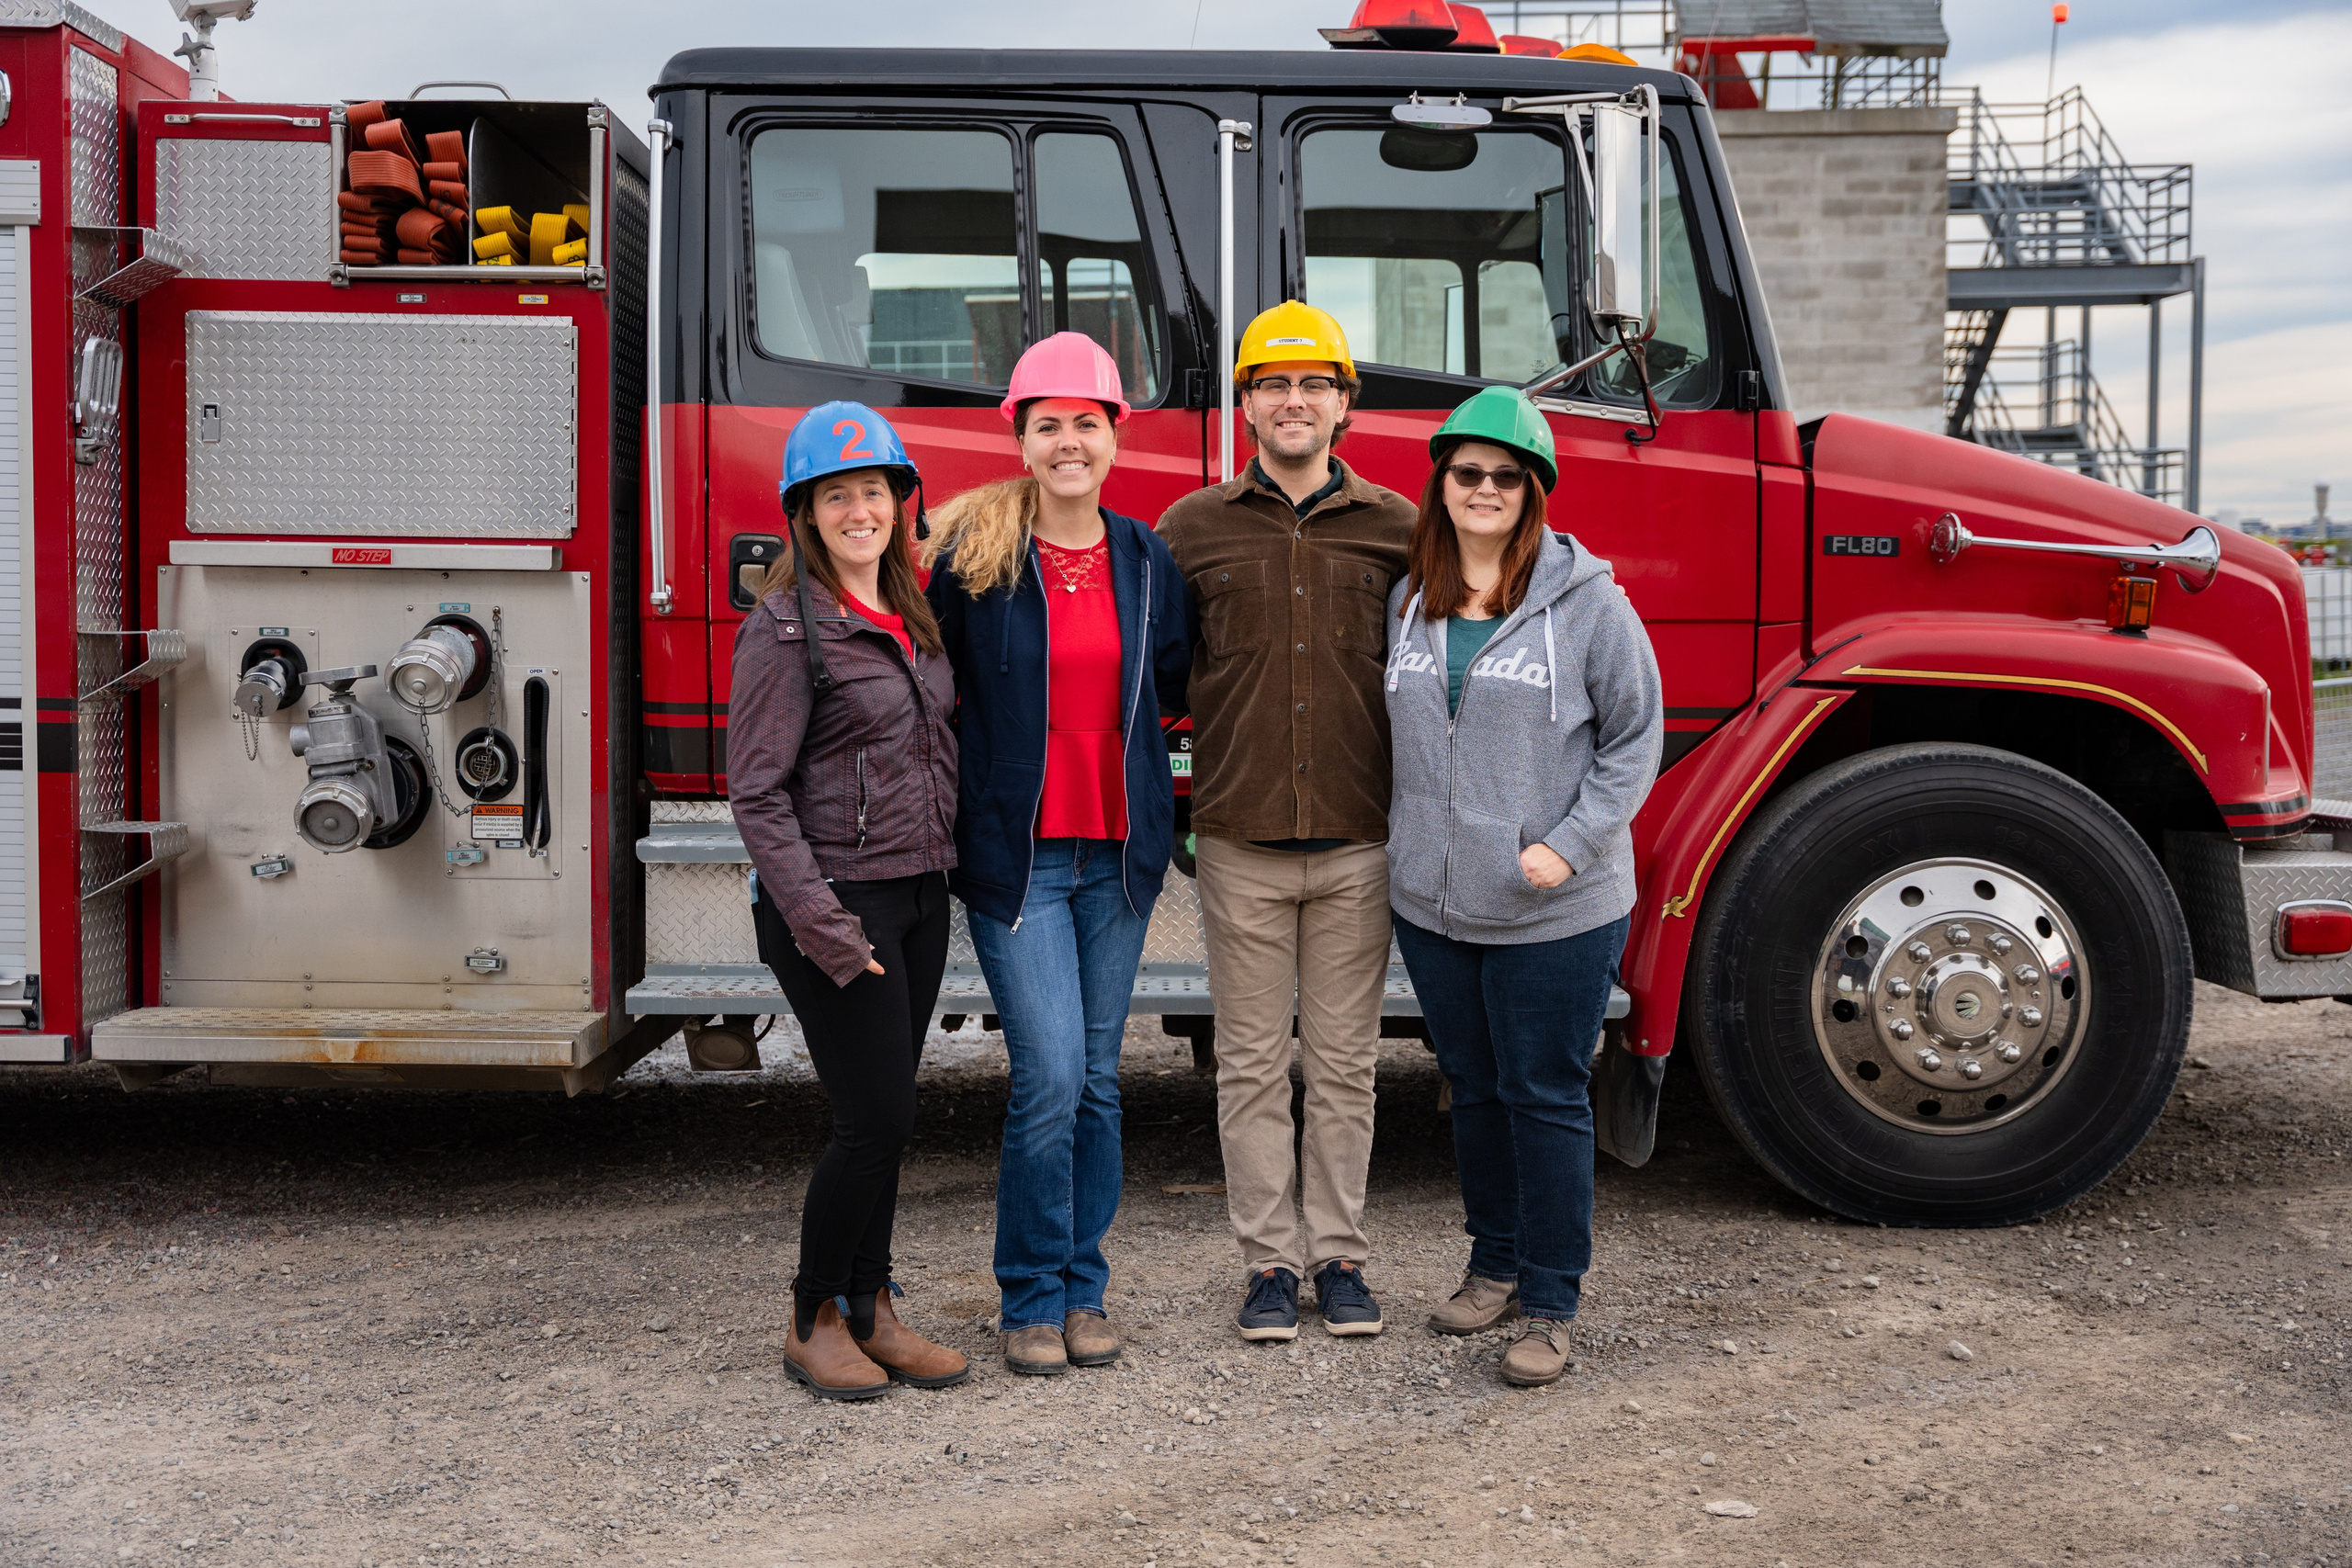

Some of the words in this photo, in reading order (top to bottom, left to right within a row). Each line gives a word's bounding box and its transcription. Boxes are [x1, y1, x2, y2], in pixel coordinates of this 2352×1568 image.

[831, 419, 874, 462] 2
[1832, 536, 1893, 555] FL80
[334, 549, 356, 562] NO
[356, 549, 390, 562] STEP
[1180, 737, 1193, 750] 5
[1772, 965, 1910, 1168] MICHELIN
